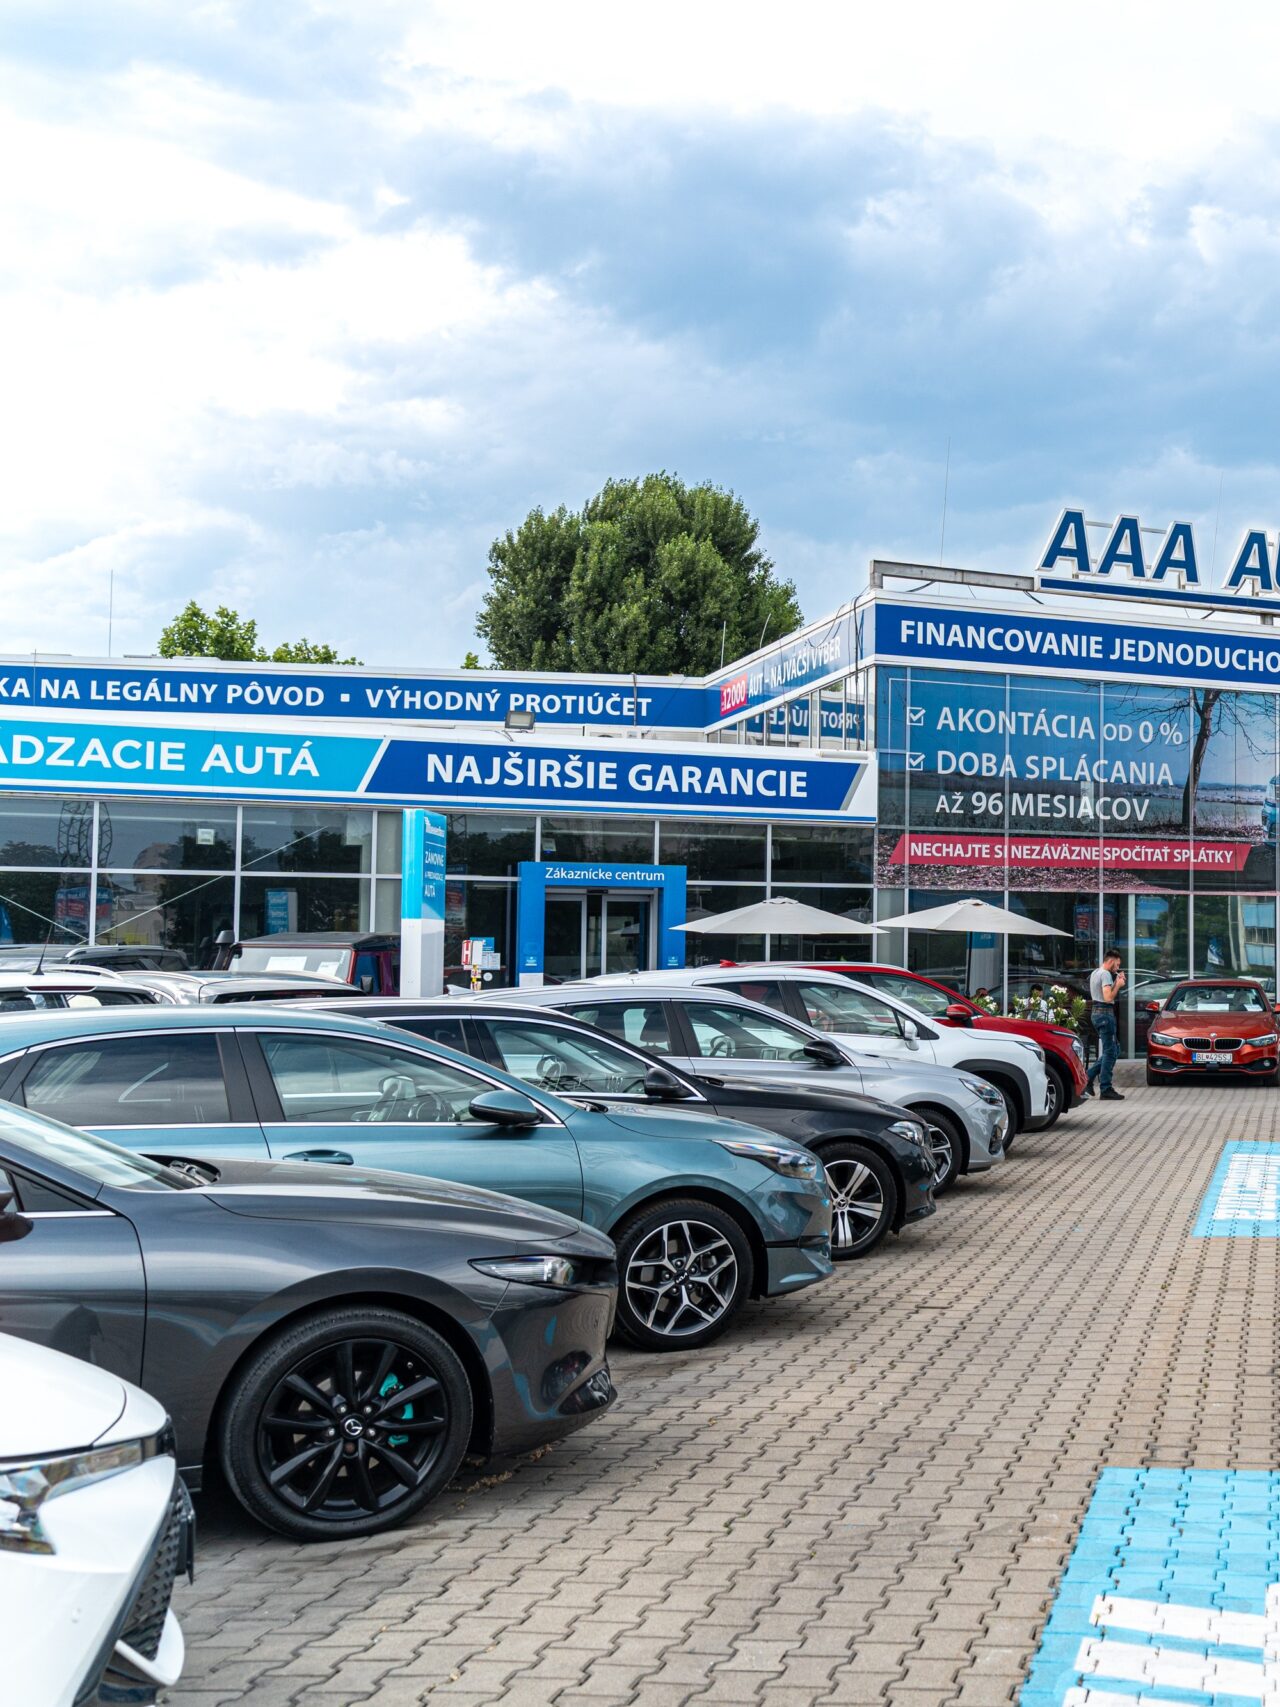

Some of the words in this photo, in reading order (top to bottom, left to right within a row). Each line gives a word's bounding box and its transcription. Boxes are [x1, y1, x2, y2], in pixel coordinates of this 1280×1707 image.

[1040, 509, 1200, 584] AAA
[901, 620, 1104, 661] FINANCOVANIE
[40, 678, 80, 699] NA
[90, 677, 218, 703] LEGÁLNY
[227, 681, 324, 707] PÔVOD
[365, 685, 501, 712] VÝHODNÝ
[509, 692, 652, 717] PROTIÚČET
[936, 707, 1095, 740] AKONTÁCIA
[1103, 723, 1132, 742] OD
[0, 733, 186, 771] DZACIE
[201, 740, 320, 777] AUTÁ
[936, 750, 1017, 779] DOBA
[1025, 754, 1174, 786] SPLÁCANIA
[427, 751, 618, 790] NAJŠIRŠIE
[628, 763, 807, 798] GARANCIE
[935, 792, 964, 814] AŽ
[971, 791, 1004, 816] 96
[1011, 793, 1150, 822] MESIACOV
[910, 842, 991, 859] NECHAJTE
[1011, 843, 1100, 861] NEZÁVÄZNE
[1103, 845, 1169, 863] SPOČÍTAŤ
[1173, 846, 1233, 864] SPLÁTKY
[545, 867, 613, 880] Zákaznícke
[615, 869, 665, 881] centrum
